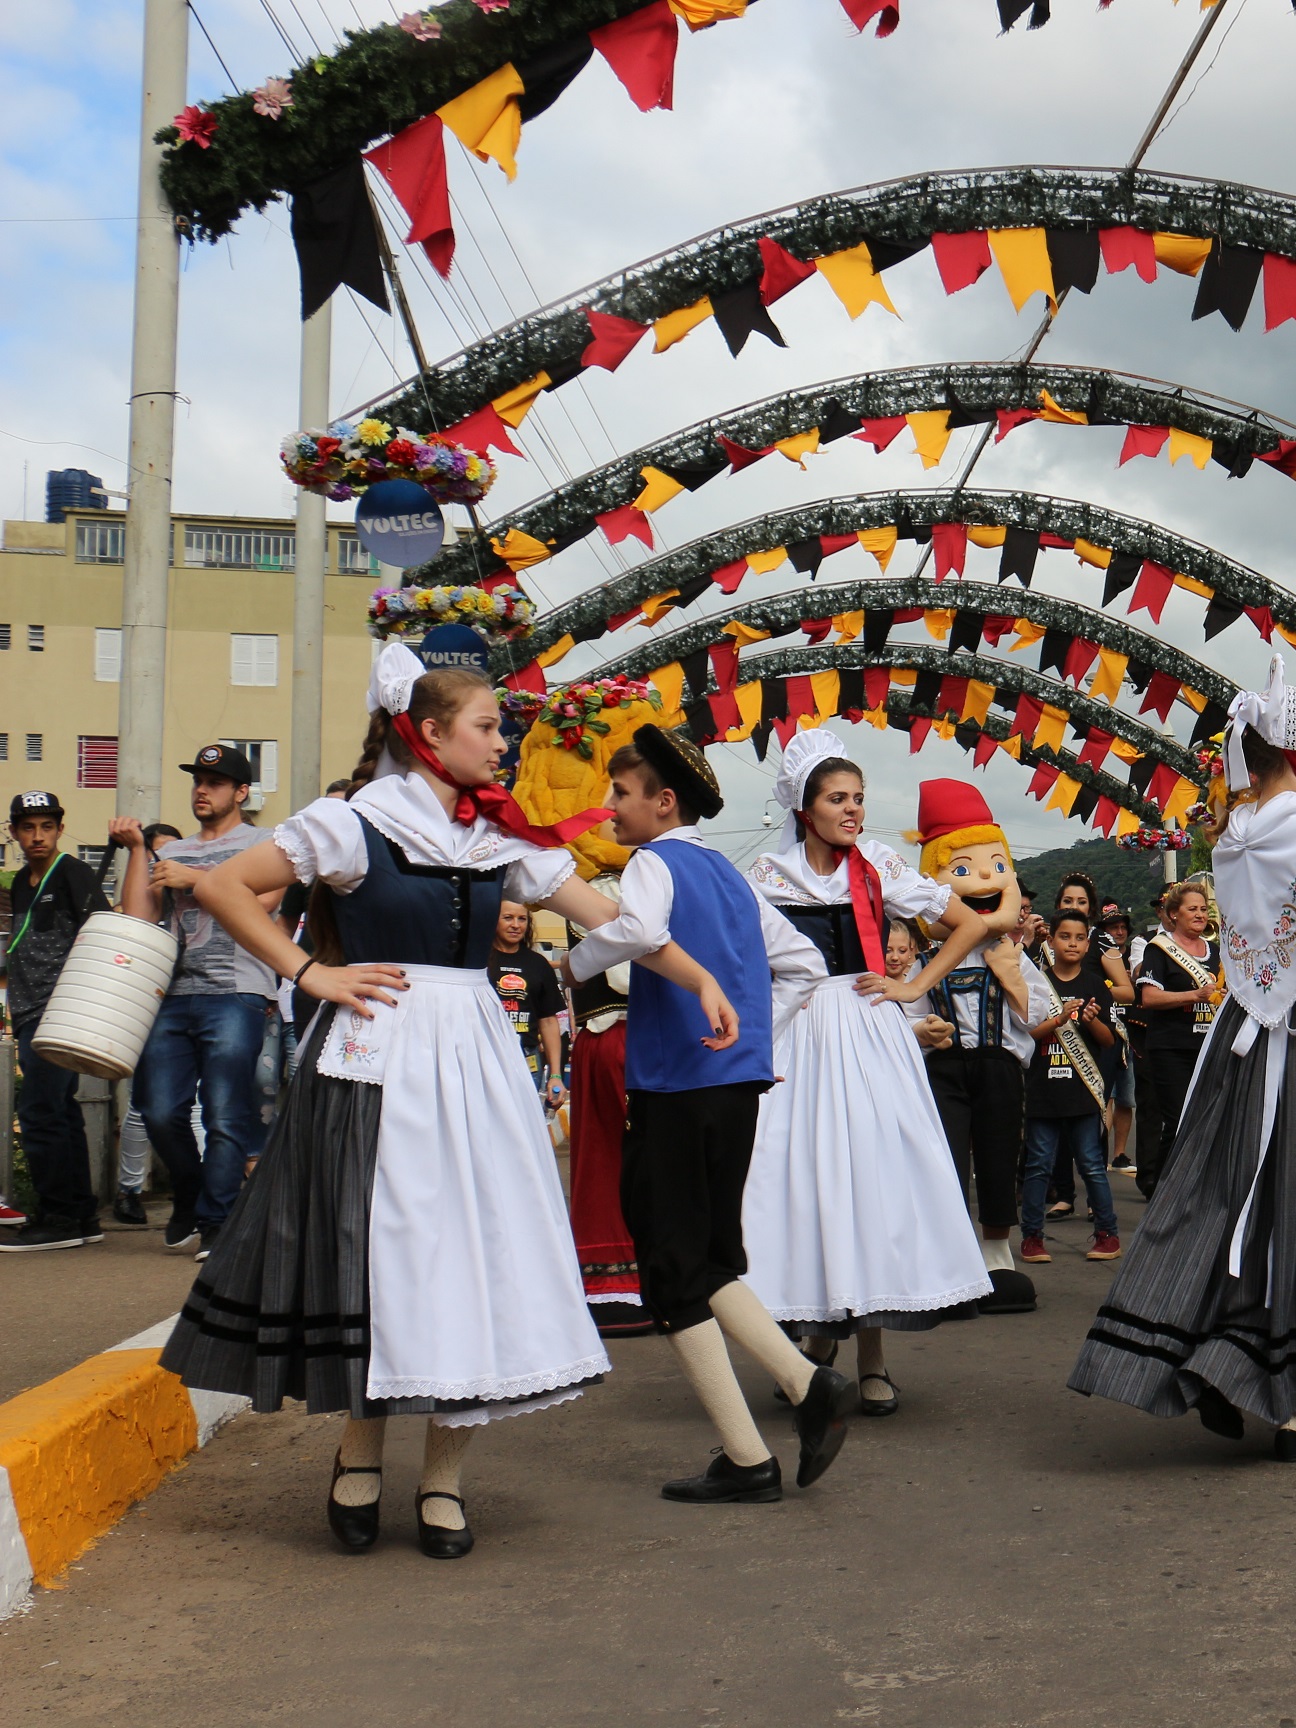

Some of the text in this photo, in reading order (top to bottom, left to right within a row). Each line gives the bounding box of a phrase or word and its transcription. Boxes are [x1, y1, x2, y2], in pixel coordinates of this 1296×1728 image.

[360, 511, 438, 535] VOLTEC
[421, 650, 482, 665] VOLTEC
[1062, 1028, 1099, 1087] Oktoberfest
